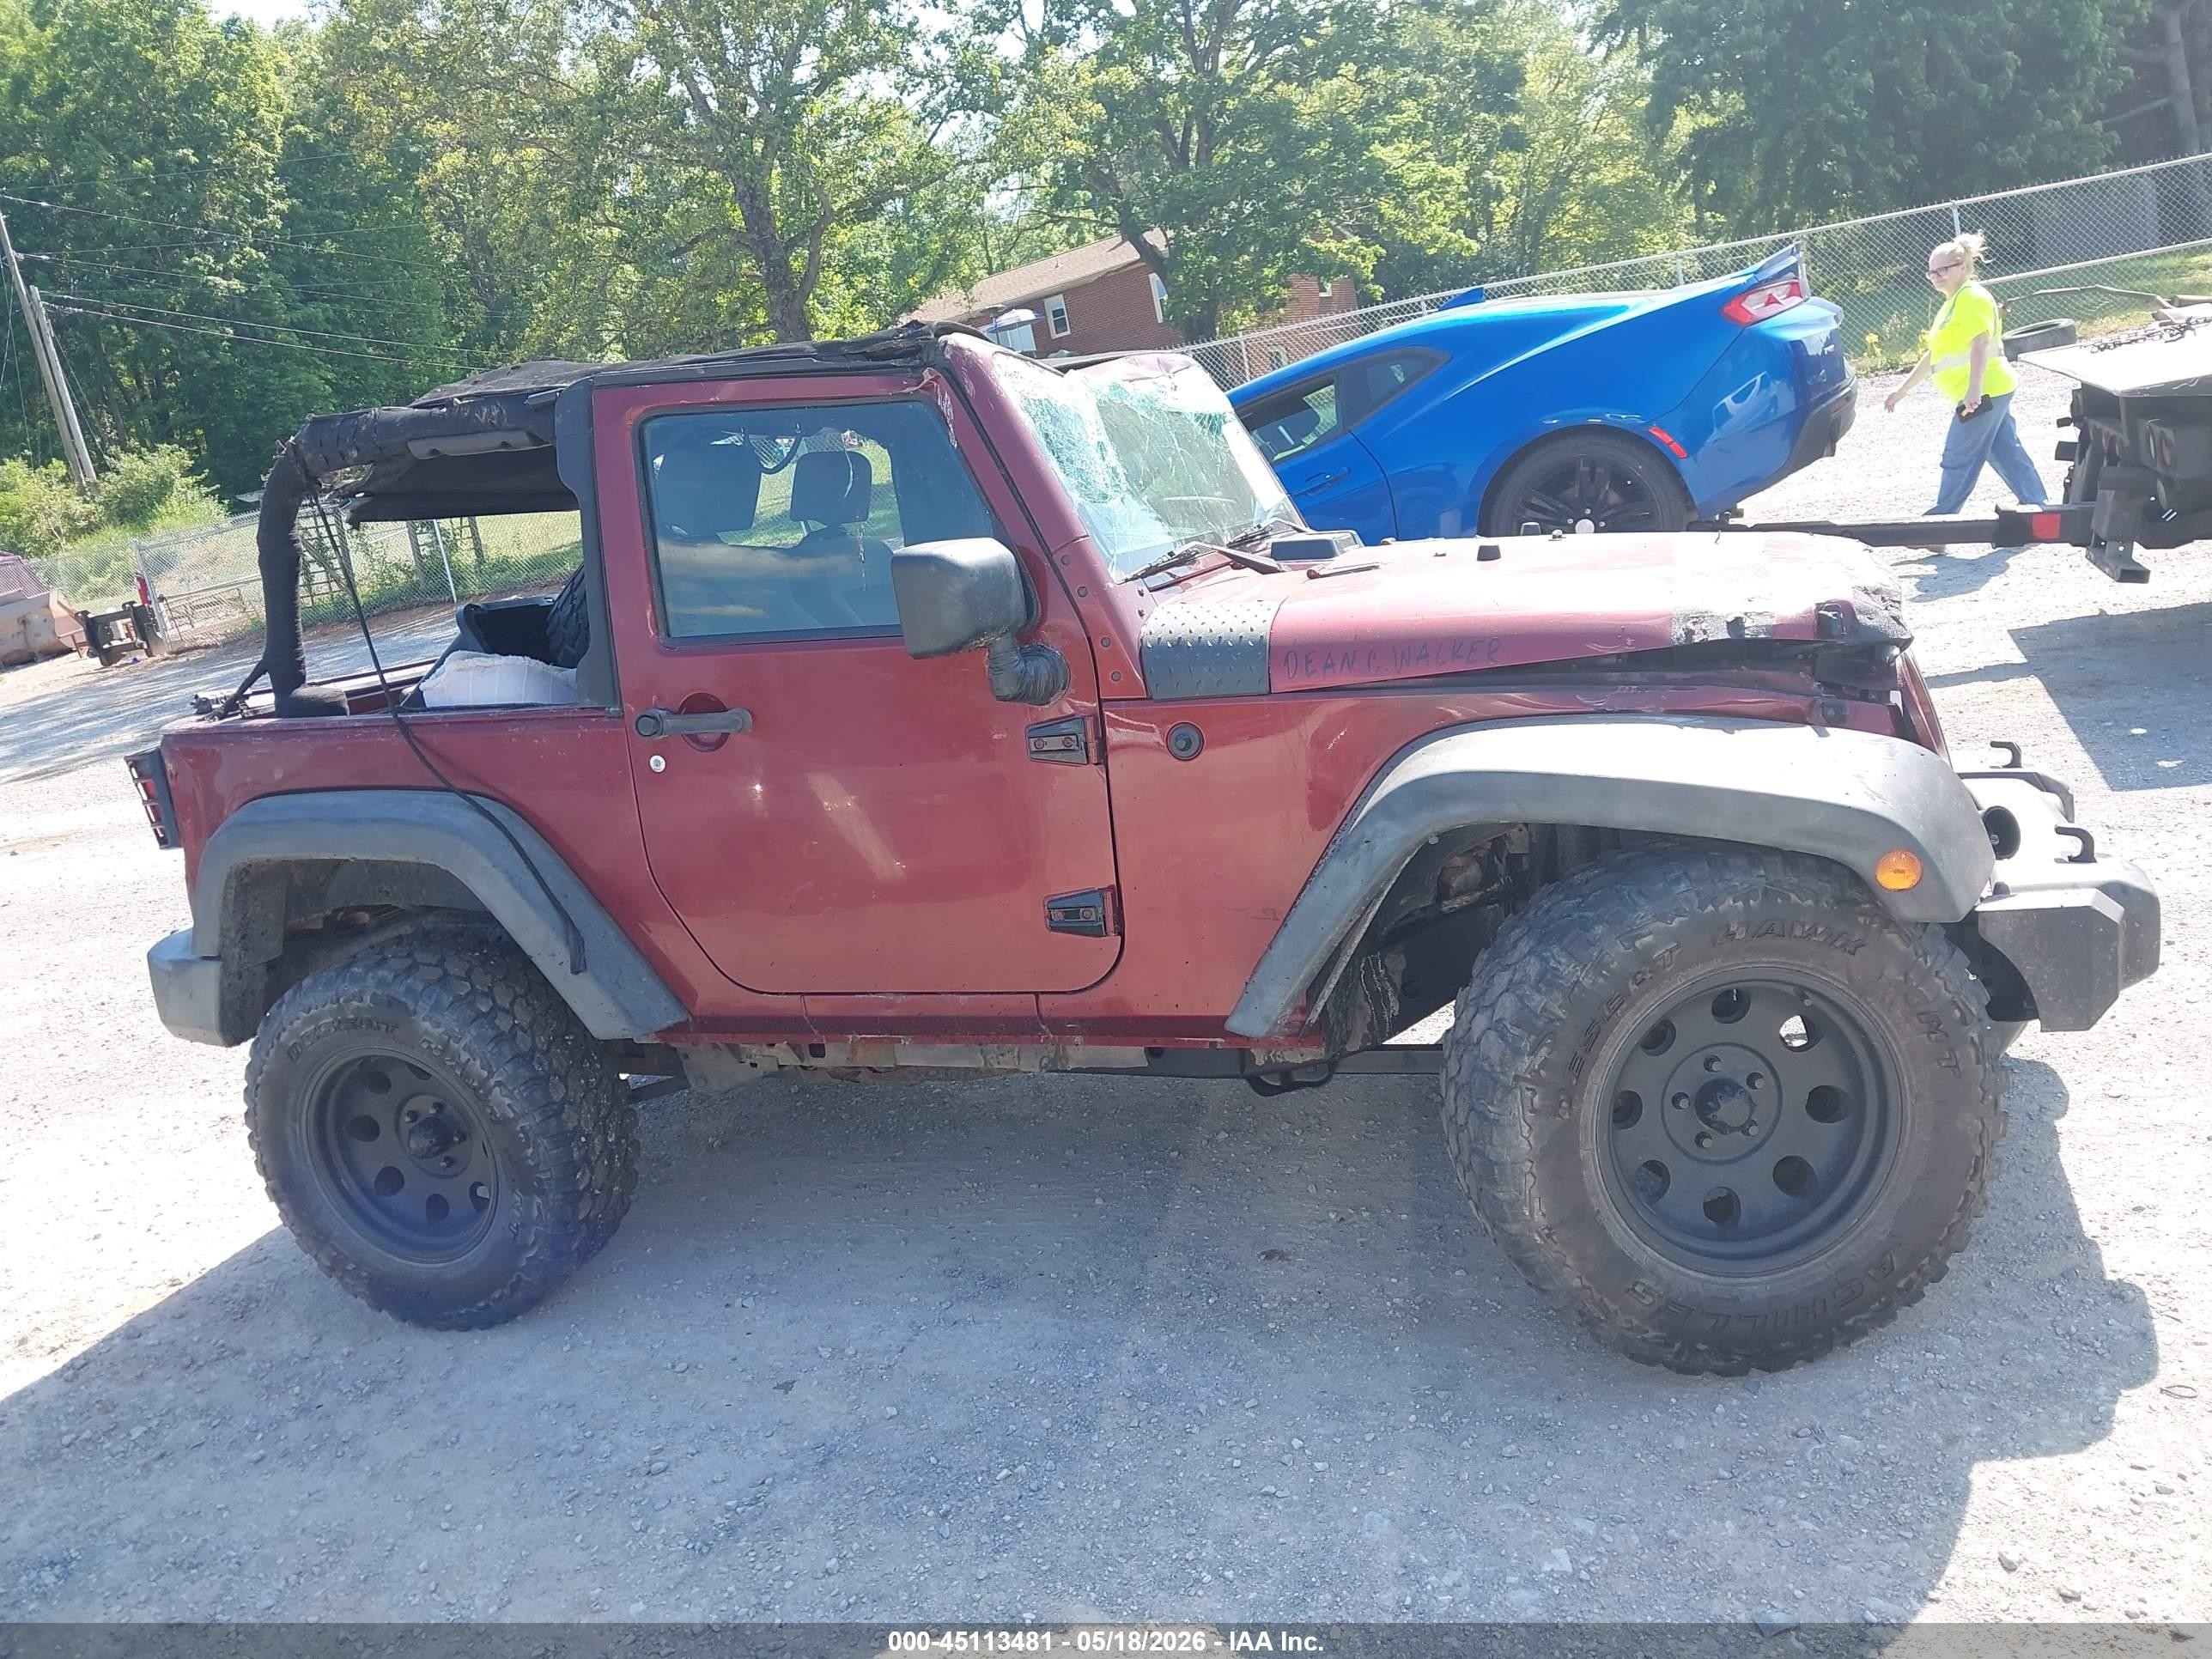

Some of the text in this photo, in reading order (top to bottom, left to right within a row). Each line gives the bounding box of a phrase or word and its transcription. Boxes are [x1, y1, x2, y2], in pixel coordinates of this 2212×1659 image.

[1393, 637, 1500, 673] WALKER
[1717, 919, 1865, 956] HAWK
[1627, 1249, 1895, 1331] ACHILLES
